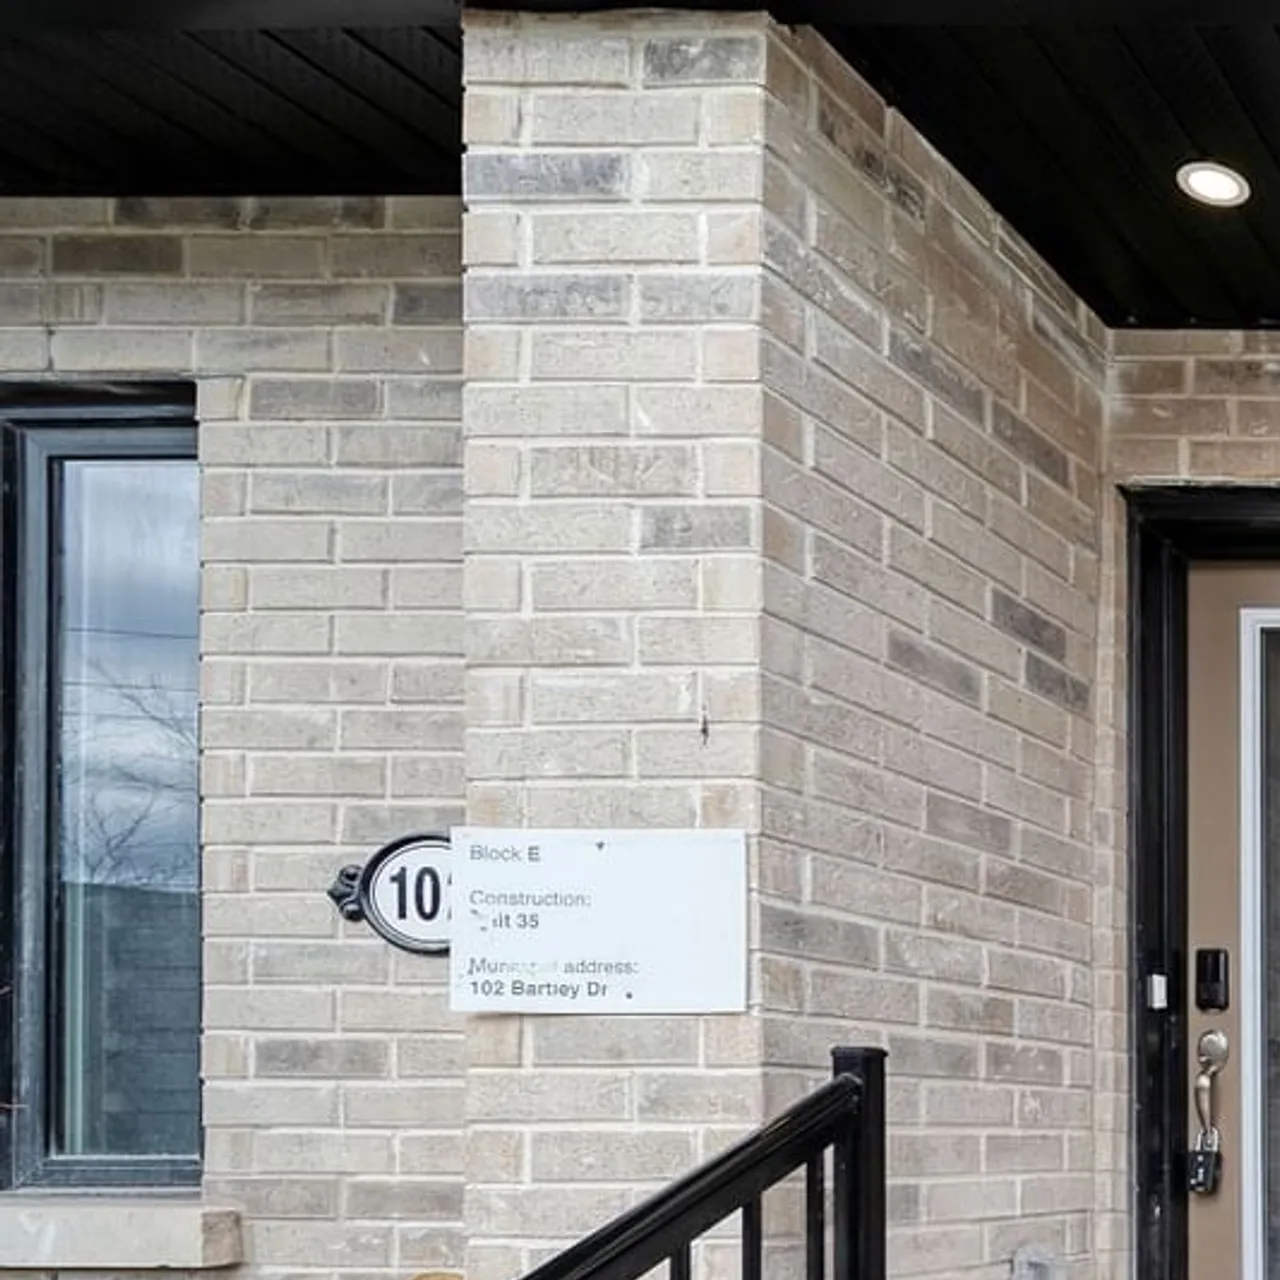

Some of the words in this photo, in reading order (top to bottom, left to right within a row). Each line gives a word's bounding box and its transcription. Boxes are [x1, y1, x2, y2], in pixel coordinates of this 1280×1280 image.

[469, 845, 522, 861] Block
[528, 846, 540, 861] E
[389, 866, 452, 921] 10
[469, 889, 592, 907] Construction:
[470, 909, 511, 930] it
[516, 913, 539, 929] 35
[470, 980, 504, 997] 102
